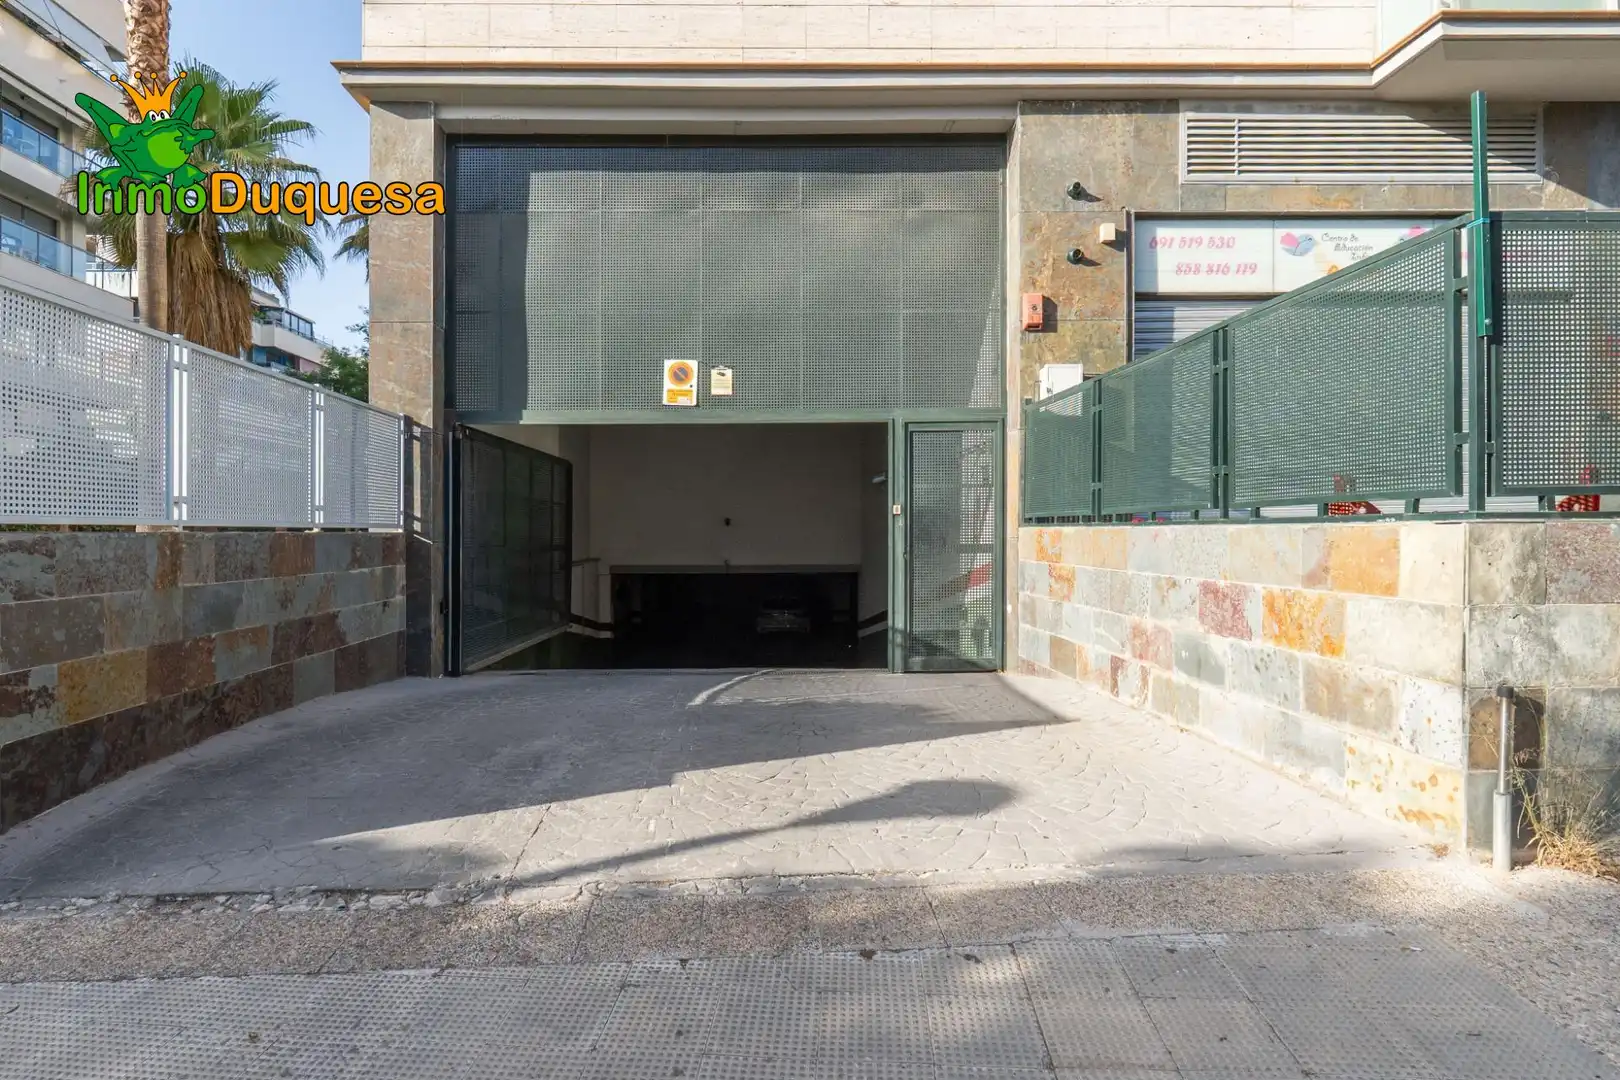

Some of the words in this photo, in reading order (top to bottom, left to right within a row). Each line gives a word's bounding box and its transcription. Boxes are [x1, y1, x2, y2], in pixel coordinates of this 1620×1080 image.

[1149, 236, 1174, 249] 691
[1179, 236, 1203, 249] 519
[1207, 236, 1236, 249] 530
[1321, 232, 1348, 242] Centro
[1175, 262, 1202, 276] 858
[1205, 262, 1231, 276] 816
